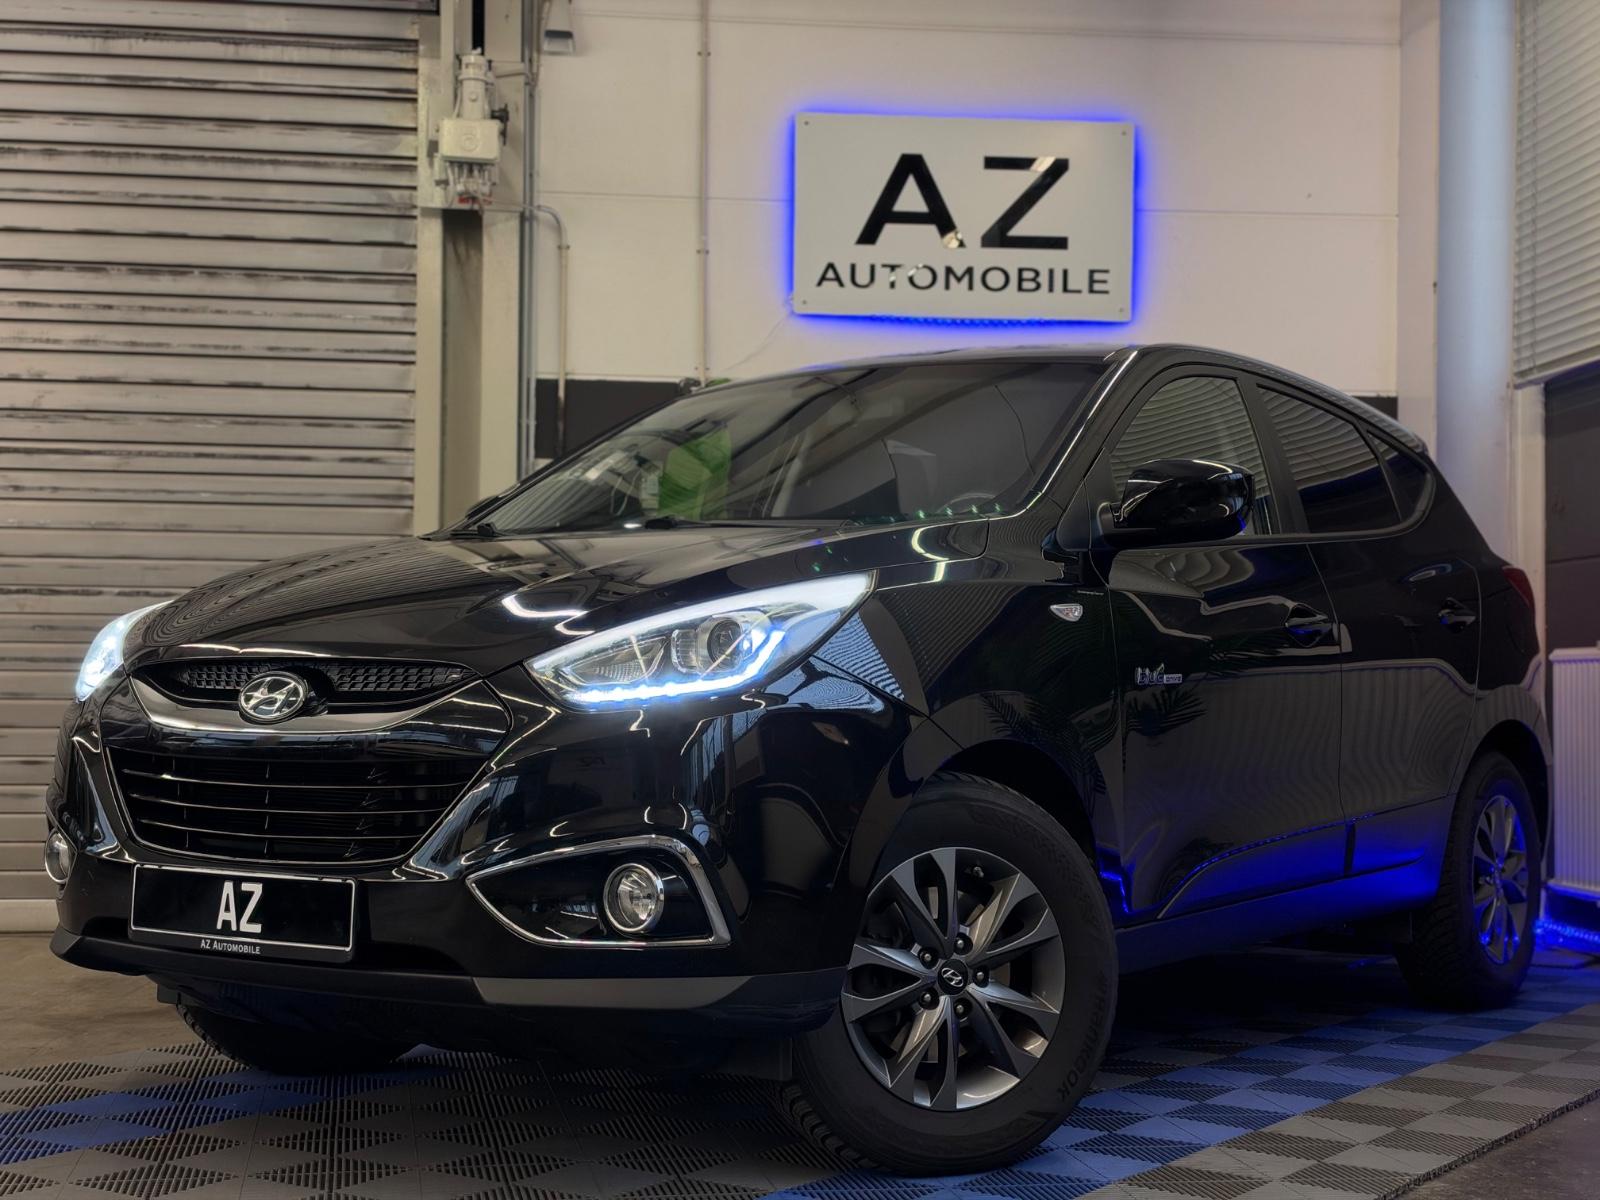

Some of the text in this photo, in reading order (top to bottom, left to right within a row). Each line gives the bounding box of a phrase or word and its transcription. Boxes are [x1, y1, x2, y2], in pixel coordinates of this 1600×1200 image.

[855, 153, 1069, 250] AZ
[815, 262, 1111, 294] AUTOMOBILE
[216, 880, 263, 933] AZ
[201, 940, 211, 949] AZ
